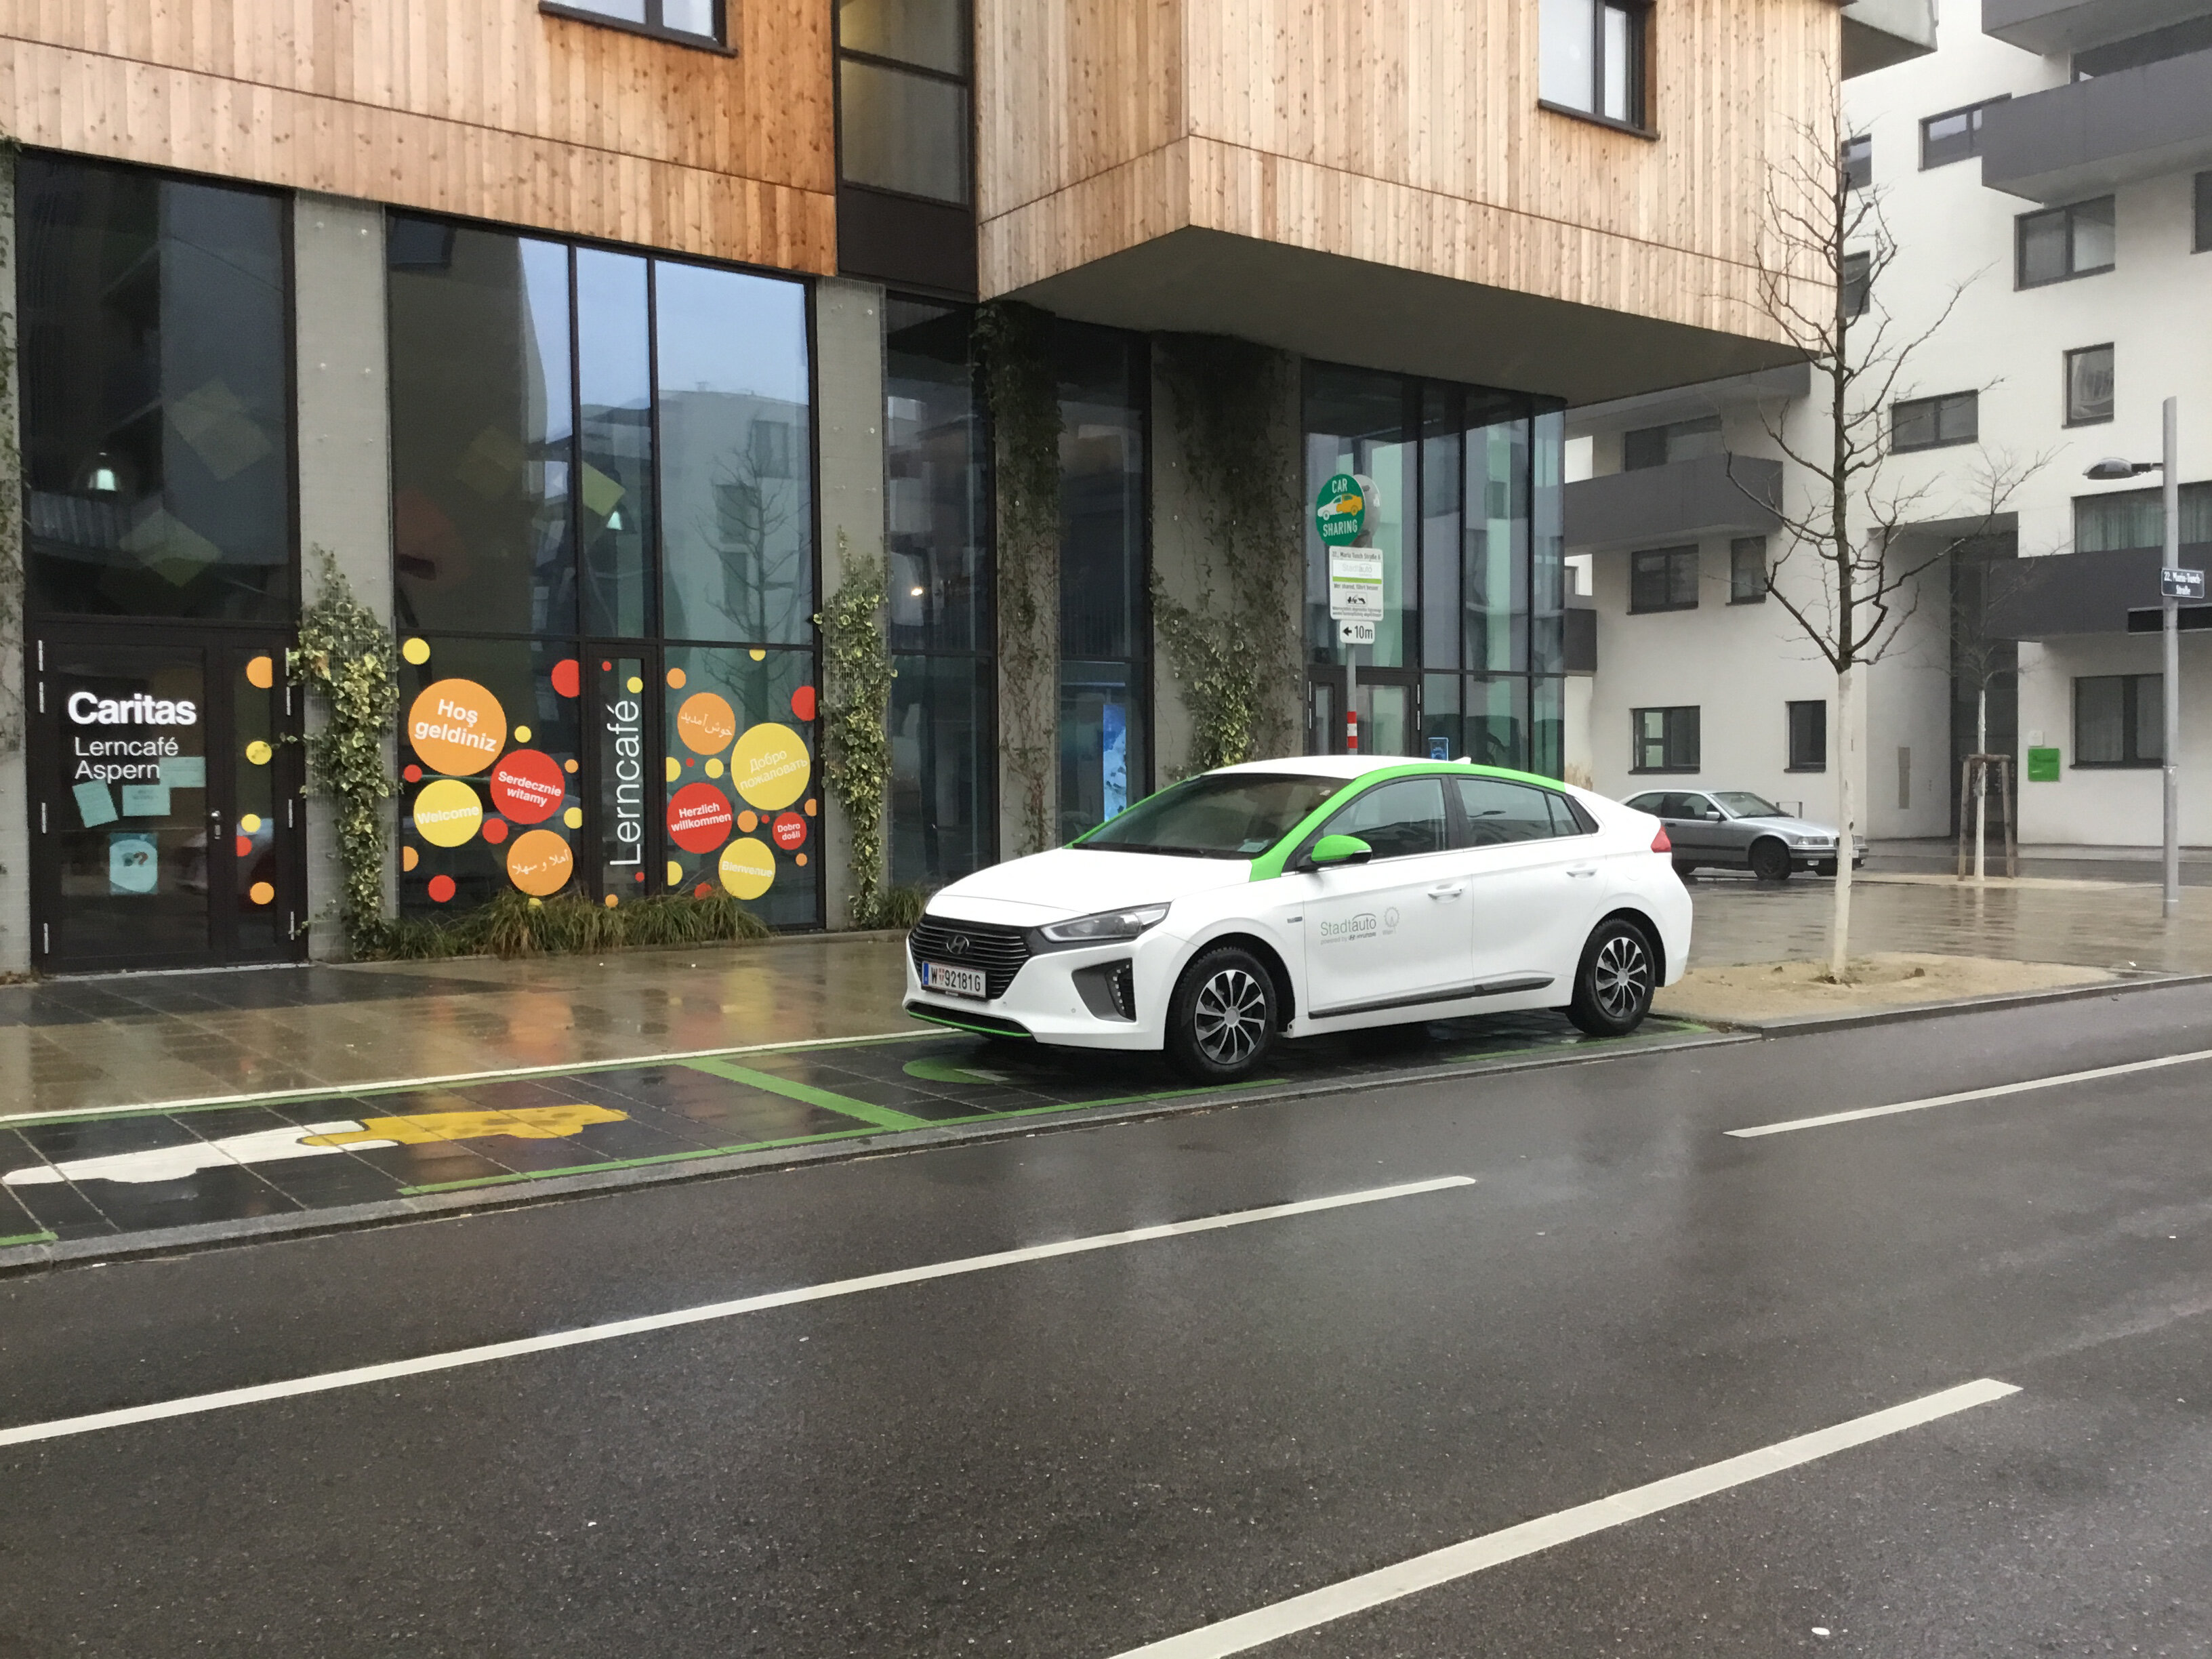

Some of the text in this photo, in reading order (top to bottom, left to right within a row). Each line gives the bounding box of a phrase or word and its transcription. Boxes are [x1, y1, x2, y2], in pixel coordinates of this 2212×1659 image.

[1332, 478, 1348, 494] CAR
[1322, 519, 1358, 537] SHARING
[1355, 625, 1373, 640] 10m
[68, 691, 197, 725] Caritas
[437, 699, 478, 728] Hoş
[414, 720, 497, 752] geldiniz
[75, 737, 179, 756] Lerncafé
[750, 750, 787, 773] Добро
[75, 760, 161, 784] Aspern
[607, 699, 641, 865] Lerncafé
[739, 758, 808, 791] пожаловать
[498, 771, 562, 797] Serdecznie
[506, 786, 548, 807] witamy
[417, 805, 480, 825] Welcome
[678, 802, 720, 819] Herzlich
[670, 813, 732, 832] willkommen
[777, 822, 801, 834] Dobro
[782, 831, 801, 841] došli
[722, 860, 773, 878] Bienvenue
[1320, 916, 1377, 937] Stadtauto
[1356, 931, 1377, 939] HYUNDAI
